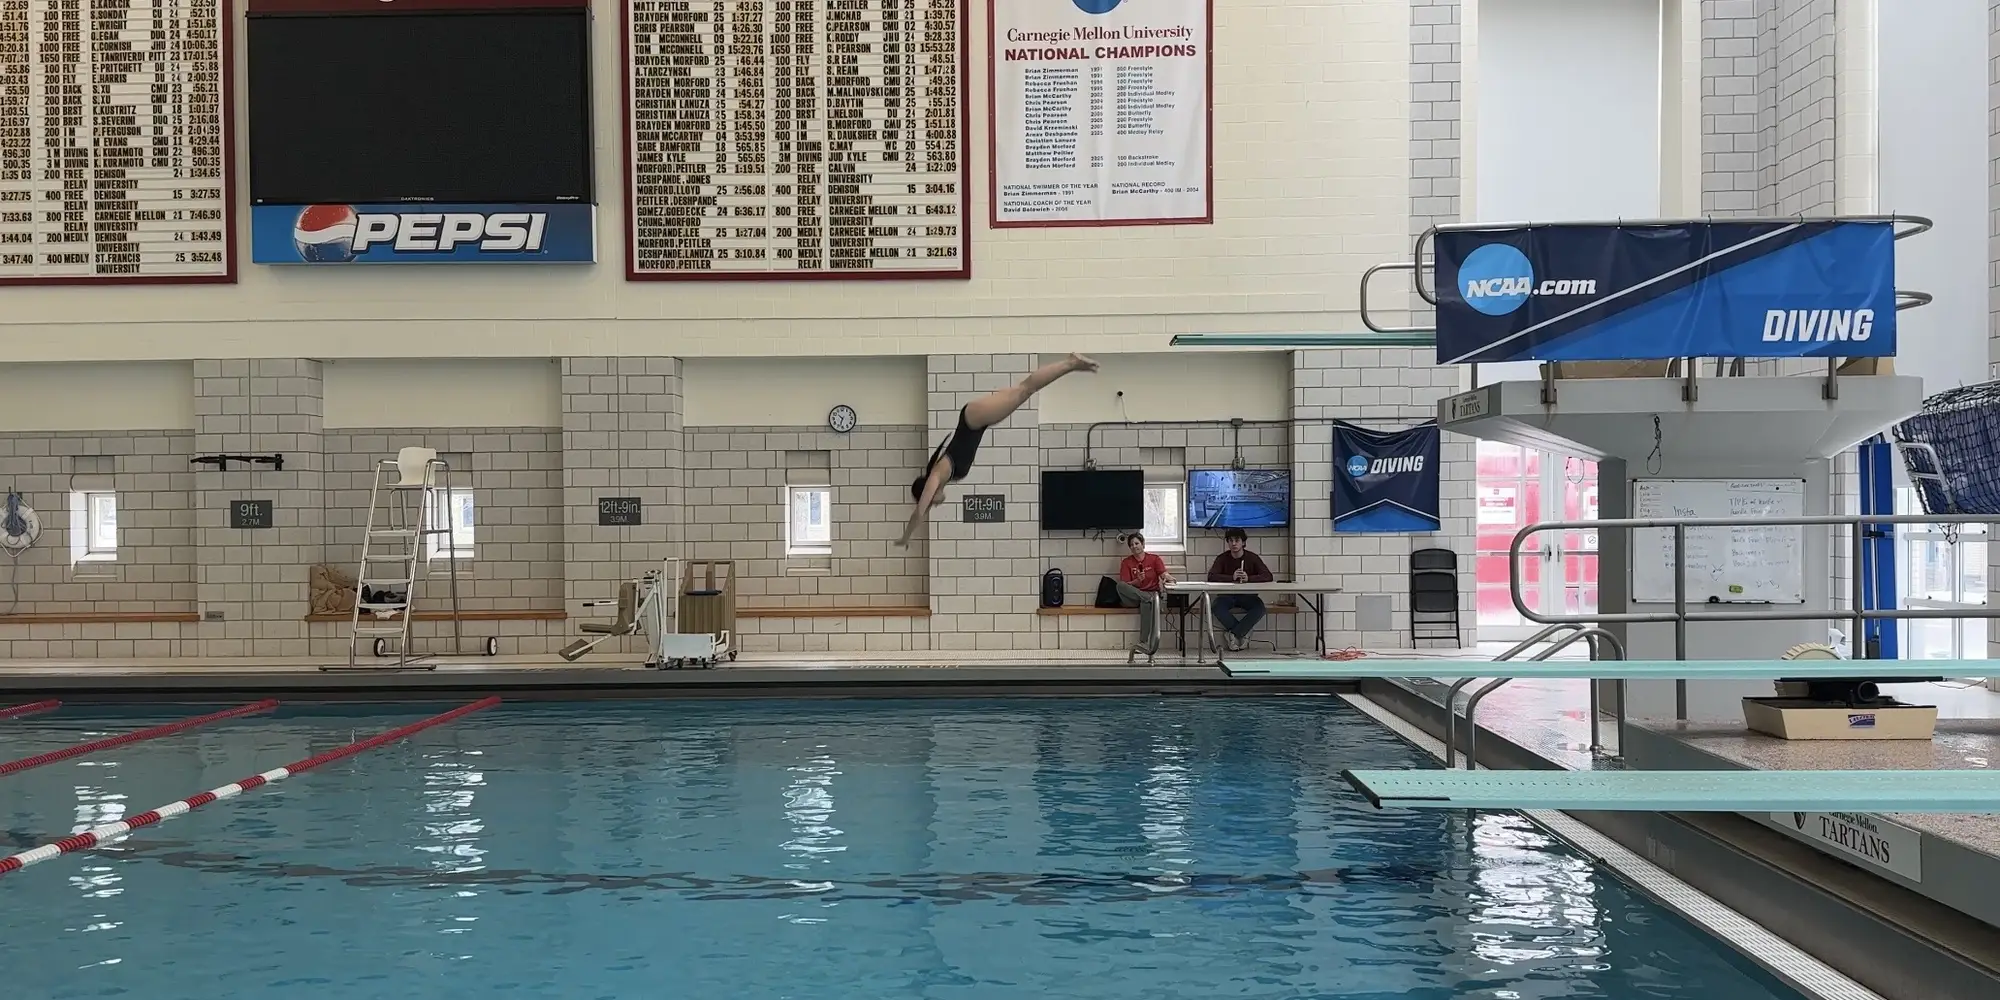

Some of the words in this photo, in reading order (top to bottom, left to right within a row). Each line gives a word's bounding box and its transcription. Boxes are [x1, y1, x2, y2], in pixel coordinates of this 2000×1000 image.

[634, 13, 669, 22] BRAYDEN
[672, 13, 708, 22] MORFORD
[714, 12, 724, 21] 25
[732, 12, 762, 21] 1:37.27
[775, 12, 790, 21] 200
[796, 12, 813, 21] FREE
[882, 11, 898, 20] CMU
[924, 10, 955, 19] 1:39.76
[634, 23, 657, 32] CHRIS
[660, 23, 695, 32] PEARSON
[714, 23, 724, 32] 04
[732, 23, 763, 32] 4:26.30
[775, 23, 790, 32] 500
[796, 23, 813, 32] FREE
[883, 22, 898, 31] CMU
[905, 22, 915, 30] 02
[925, 21, 955, 30] 4:30.57
[44, 32, 59, 41] 500
[62, 32, 80, 41] FREE
[170, 31, 180, 39] 24
[187, 31, 216, 39] 4:50.17
[1007, 28, 1070, 44] Carnegie
[1073, 26, 1120, 40] Mellon
[1123, 25, 1193, 41] University
[40, 54, 59, 62] 1650
[62, 53, 80, 62] FREE
[170, 53, 180, 61] 23
[183, 52, 218, 61] 17:01.54
[1005, 48, 1089, 61] NATIONAL
[1095, 45, 1196, 58] CHAMPIONS
[715, 68, 725, 76] 23
[734, 67, 764, 76] 1:46.84
[776, 67, 790, 76] 200
[796, 66, 809, 75] FLY
[837, 66, 858, 74] REAM
[884, 65, 900, 74] CMU
[635, 89, 671, 98] BRAYDEN
[674, 89, 710, 98] MORFORD
[716, 89, 725, 98] 24
[734, 89, 765, 98] 1:45.64
[776, 89, 791, 98] 200
[796, 88, 815, 97] BACK
[905, 87, 915, 96] 25
[925, 87, 956, 96] 1:48.52
[1, 107, 29, 116] 1:03.51
[45, 106, 59, 115] 100
[62, 106, 82, 115] BRST
[172, 105, 182, 114] 18
[188, 105, 218, 114] 1:01.97
[667, 153, 686, 162] KYLE
[716, 153, 726, 162] 20
[738, 153, 765, 162] 565.65
[779, 153, 790, 162] 3M
[797, 153, 822, 162] DIVING
[828, 152, 843, 161] JUD
[847, 152, 867, 161] KYLE
[883, 152, 899, 161] CMU
[927, 151, 956, 160] 563.80
[1, 192, 31, 201] 3:27.75
[45, 191, 60, 200] 400
[64, 191, 83, 199] FREE
[173, 190, 182, 199] 15
[190, 190, 220, 198] 3:27.53
[46, 212, 61, 221] 800
[64, 212, 84, 221] FREE
[95, 211, 131, 220] CARNEGIE
[135, 211, 166, 220] MELLON
[190, 211, 221, 219] 7:46.90
[717, 207, 728, 215] 24
[735, 207, 765, 216] 6:36.17
[776, 207, 790, 215] 800
[798, 206, 815, 215] FREE
[830, 206, 866, 215] CARNEGIE
[868, 206, 897, 215] MELLON
[926, 205, 956, 214] 6:43.12
[798, 217, 821, 226] RELAY
[829, 217, 873, 226] UNIVERSITY
[352, 213, 547, 251] PEPSI
[3, 255, 33, 264] 3:47.40
[47, 255, 62, 263] 400
[64, 254, 89, 263] MEDLY
[176, 253, 185, 262] 25
[191, 253, 222, 262] 3:52.48
[96, 264, 140, 273] UNIVERSITY
[1762, 308, 1874, 342] DIVING
[1370, 455, 1424, 474] DIVING
[241, 504, 263, 516] 9ft.
[1819, 816, 1890, 863] TARTANS
